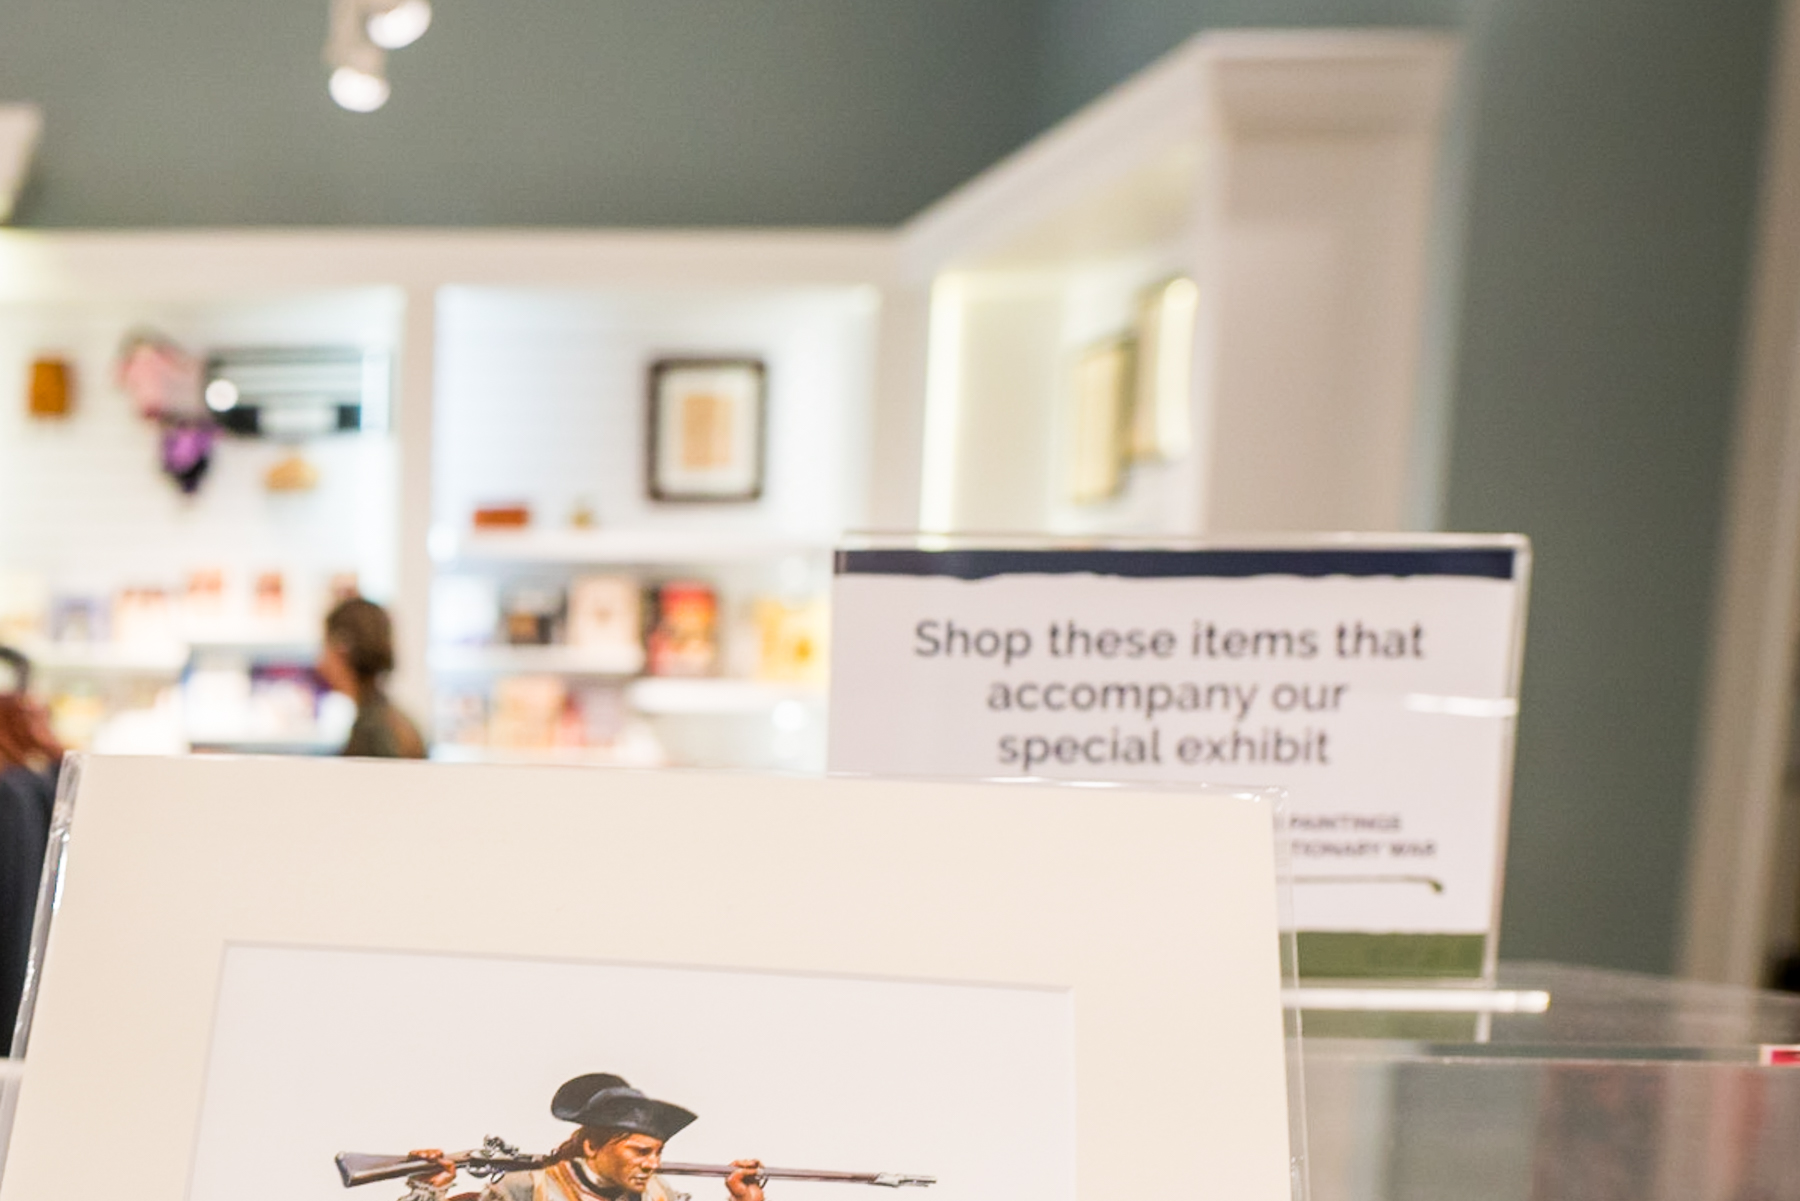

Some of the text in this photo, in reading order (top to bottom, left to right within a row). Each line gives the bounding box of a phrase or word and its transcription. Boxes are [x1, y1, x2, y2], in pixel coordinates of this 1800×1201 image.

[914, 620, 1424, 666] Shop these items that
[986, 682, 1347, 719] accompany our
[998, 727, 1329, 770] special exhibit
[1289, 813, 1402, 832] PAINTINGS
[1387, 841, 1437, 858] WAR
